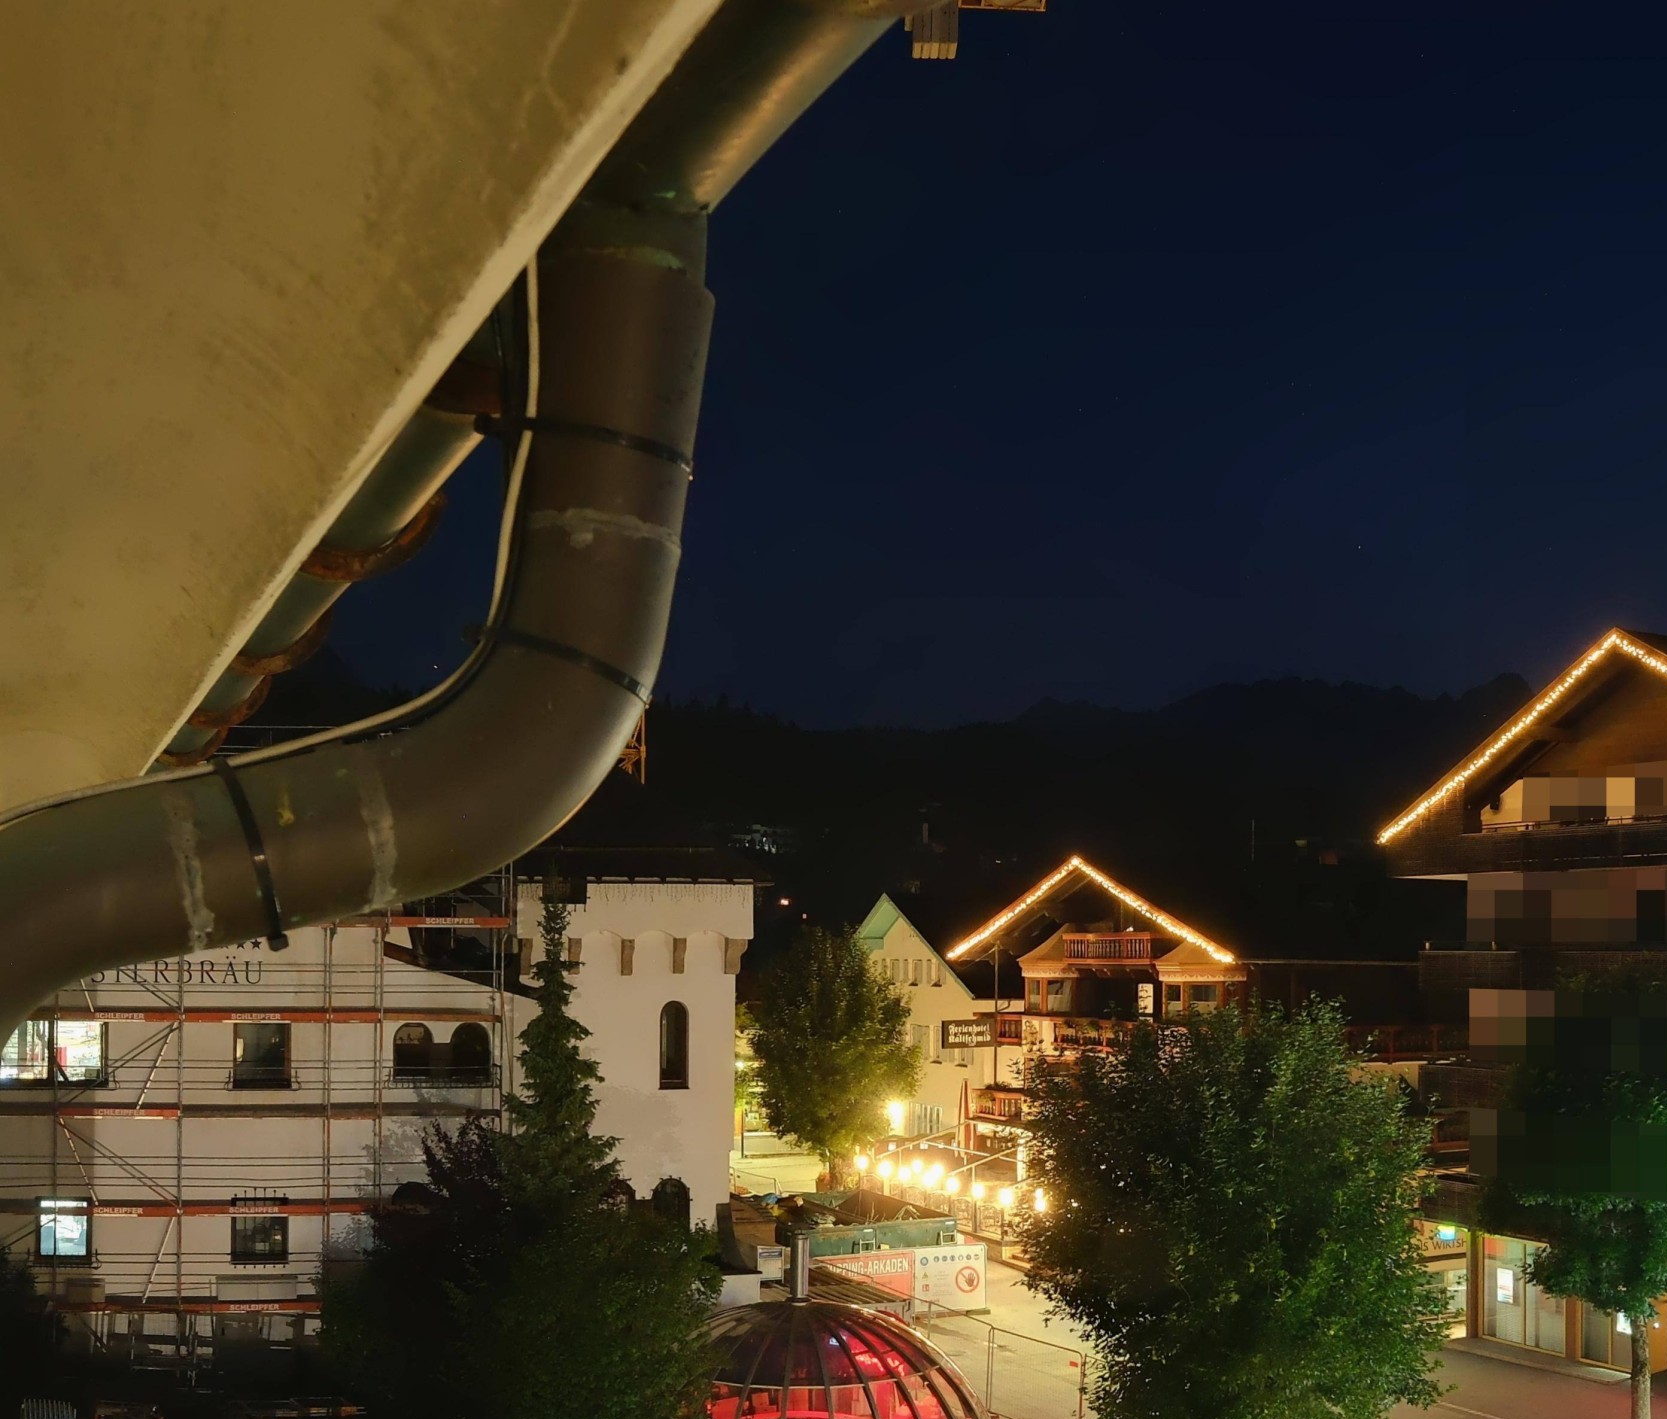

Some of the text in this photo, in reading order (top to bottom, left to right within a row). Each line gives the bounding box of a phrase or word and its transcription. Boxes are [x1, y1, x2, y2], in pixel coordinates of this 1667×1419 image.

[425, 917, 475, 925] SCHLEIPFER
[95, 1012, 144, 1020] SCHLEIPFER
[231, 1012, 280, 1020] SCHLEIPFER
[93, 1109, 145, 1117] SCHLEIPFER
[93, 1206, 143, 1215] SCHLEIPFER
[229, 1206, 279, 1214] SCHLEIPFER
[229, 1303, 279, 1311] SCHLEIPFER
